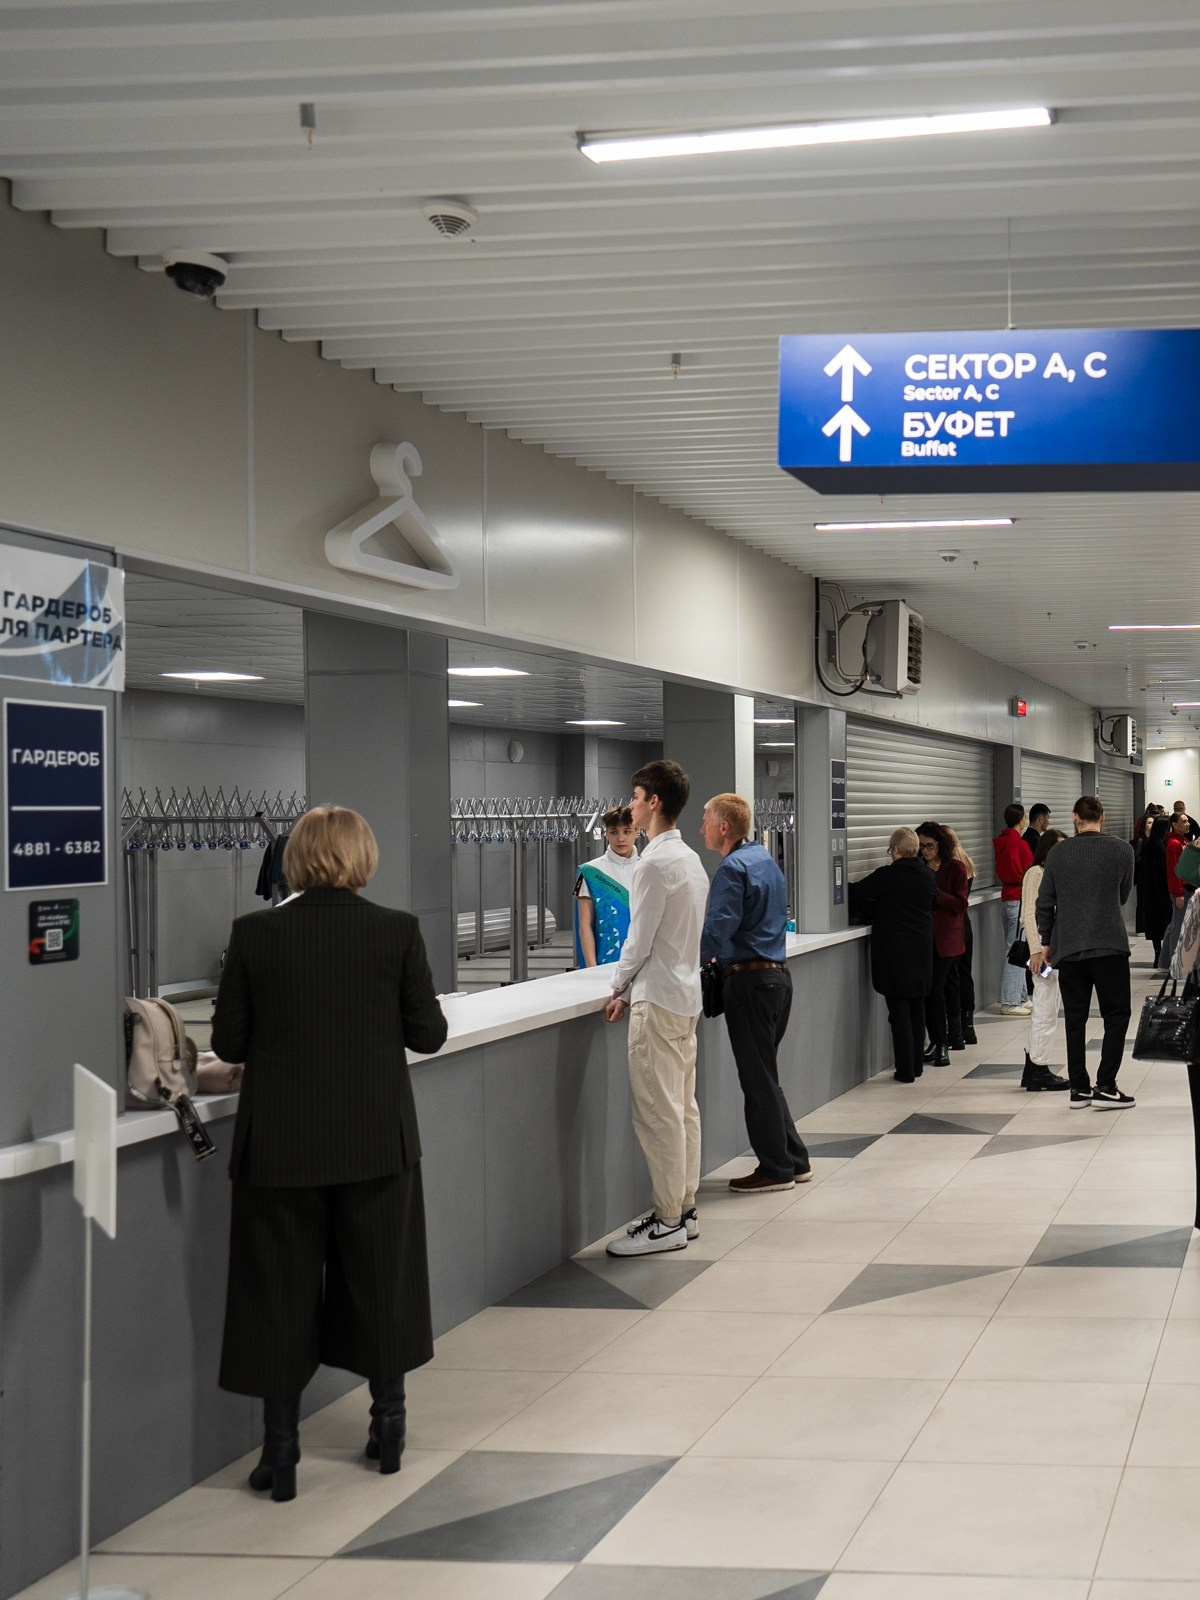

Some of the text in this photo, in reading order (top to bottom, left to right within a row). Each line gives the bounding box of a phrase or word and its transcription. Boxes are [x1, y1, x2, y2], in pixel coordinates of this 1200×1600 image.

[904, 351, 1108, 383] СЕКТОР А, С
[903, 383, 1000, 402] Sector A, C
[902, 410, 1016, 438] БУФЕТ
[901, 440, 957, 457] Buffet
[4, 590, 112, 625] ГАРДЕРОБ
[0, 617, 123, 652] ЛЯ ПАРТЕРА
[11, 748, 101, 767] ГАРДЕРОБ
[13, 841, 51, 857] 4881
[65, 840, 101, 855] 6382
